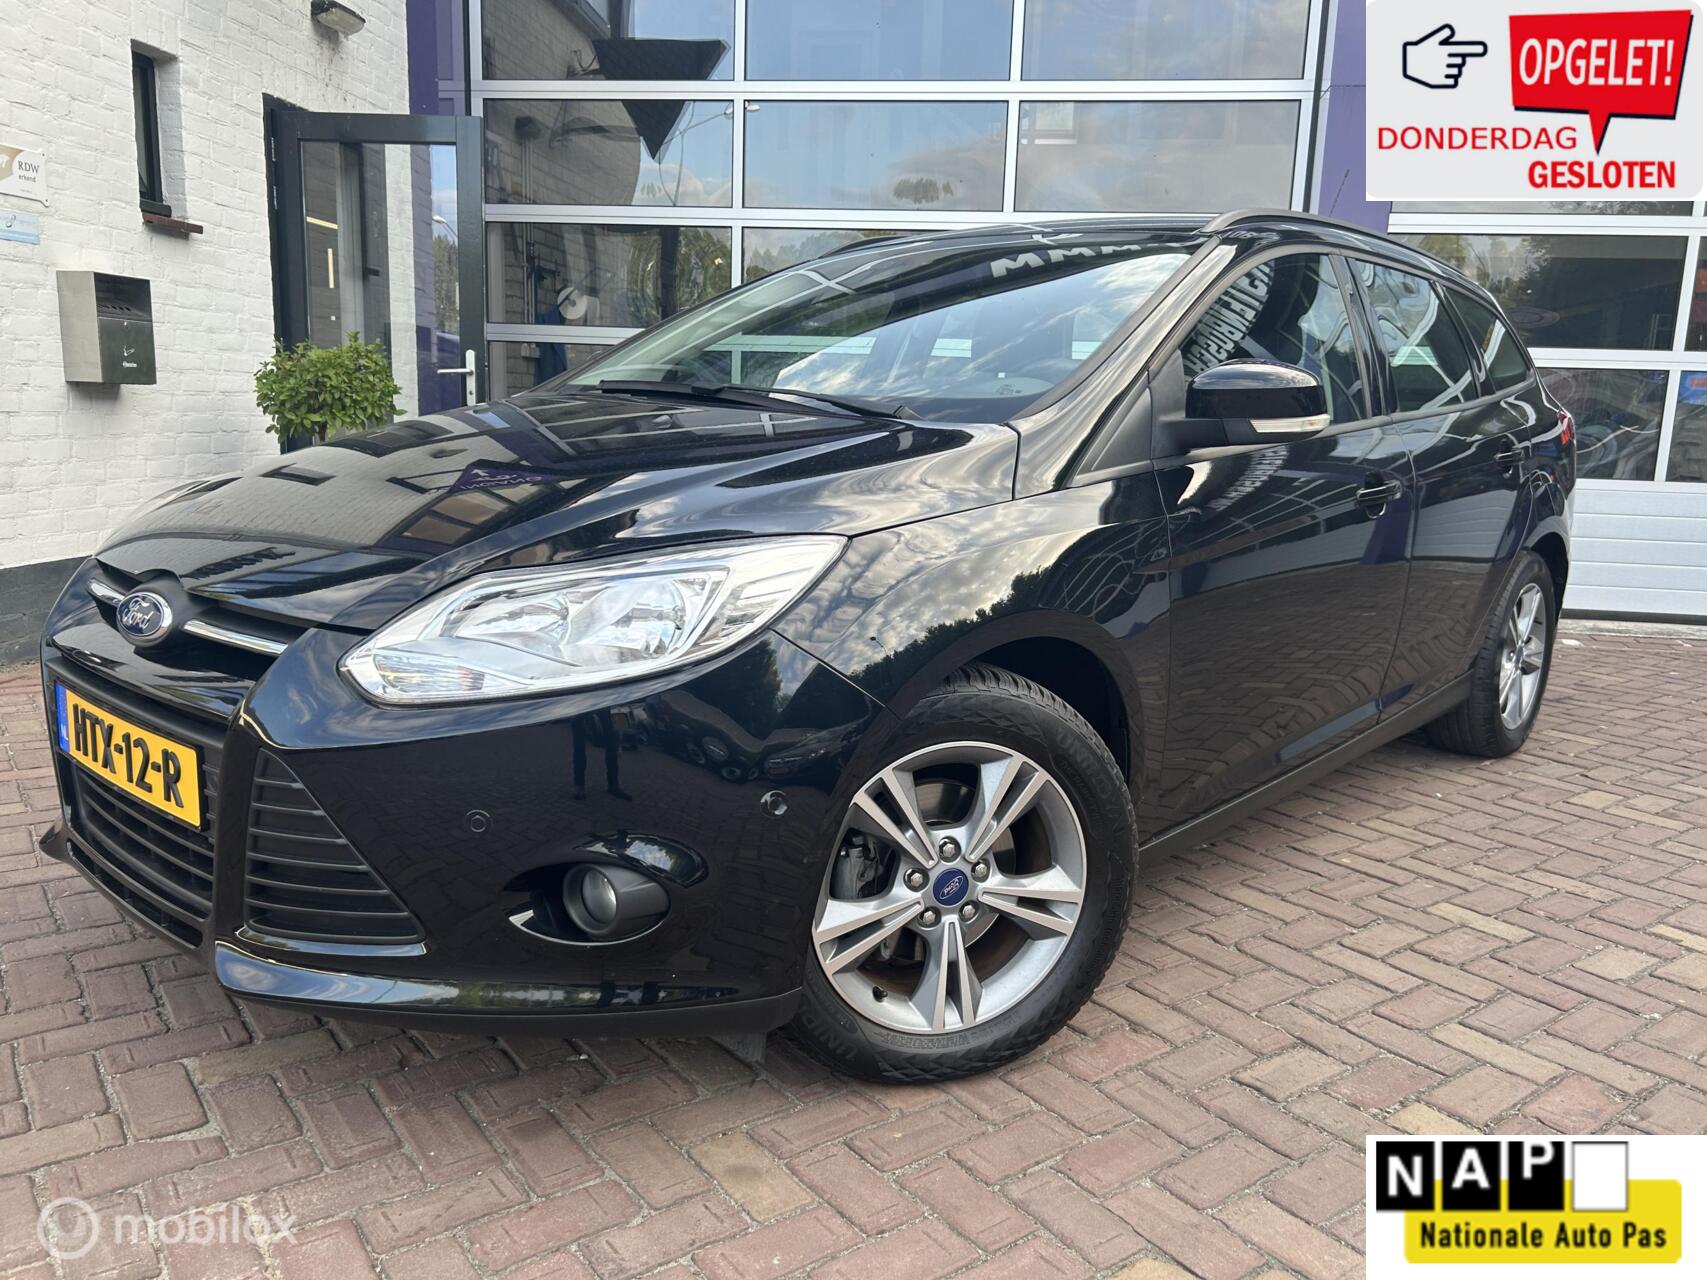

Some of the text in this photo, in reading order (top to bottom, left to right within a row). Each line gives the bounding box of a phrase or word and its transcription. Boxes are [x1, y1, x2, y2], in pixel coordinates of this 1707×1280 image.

[18, 159, 40, 174] RDW
[122, 597, 155, 630] Ford
[60, 723, 69, 741] NL
[72, 703, 184, 809] HTX-12-R
